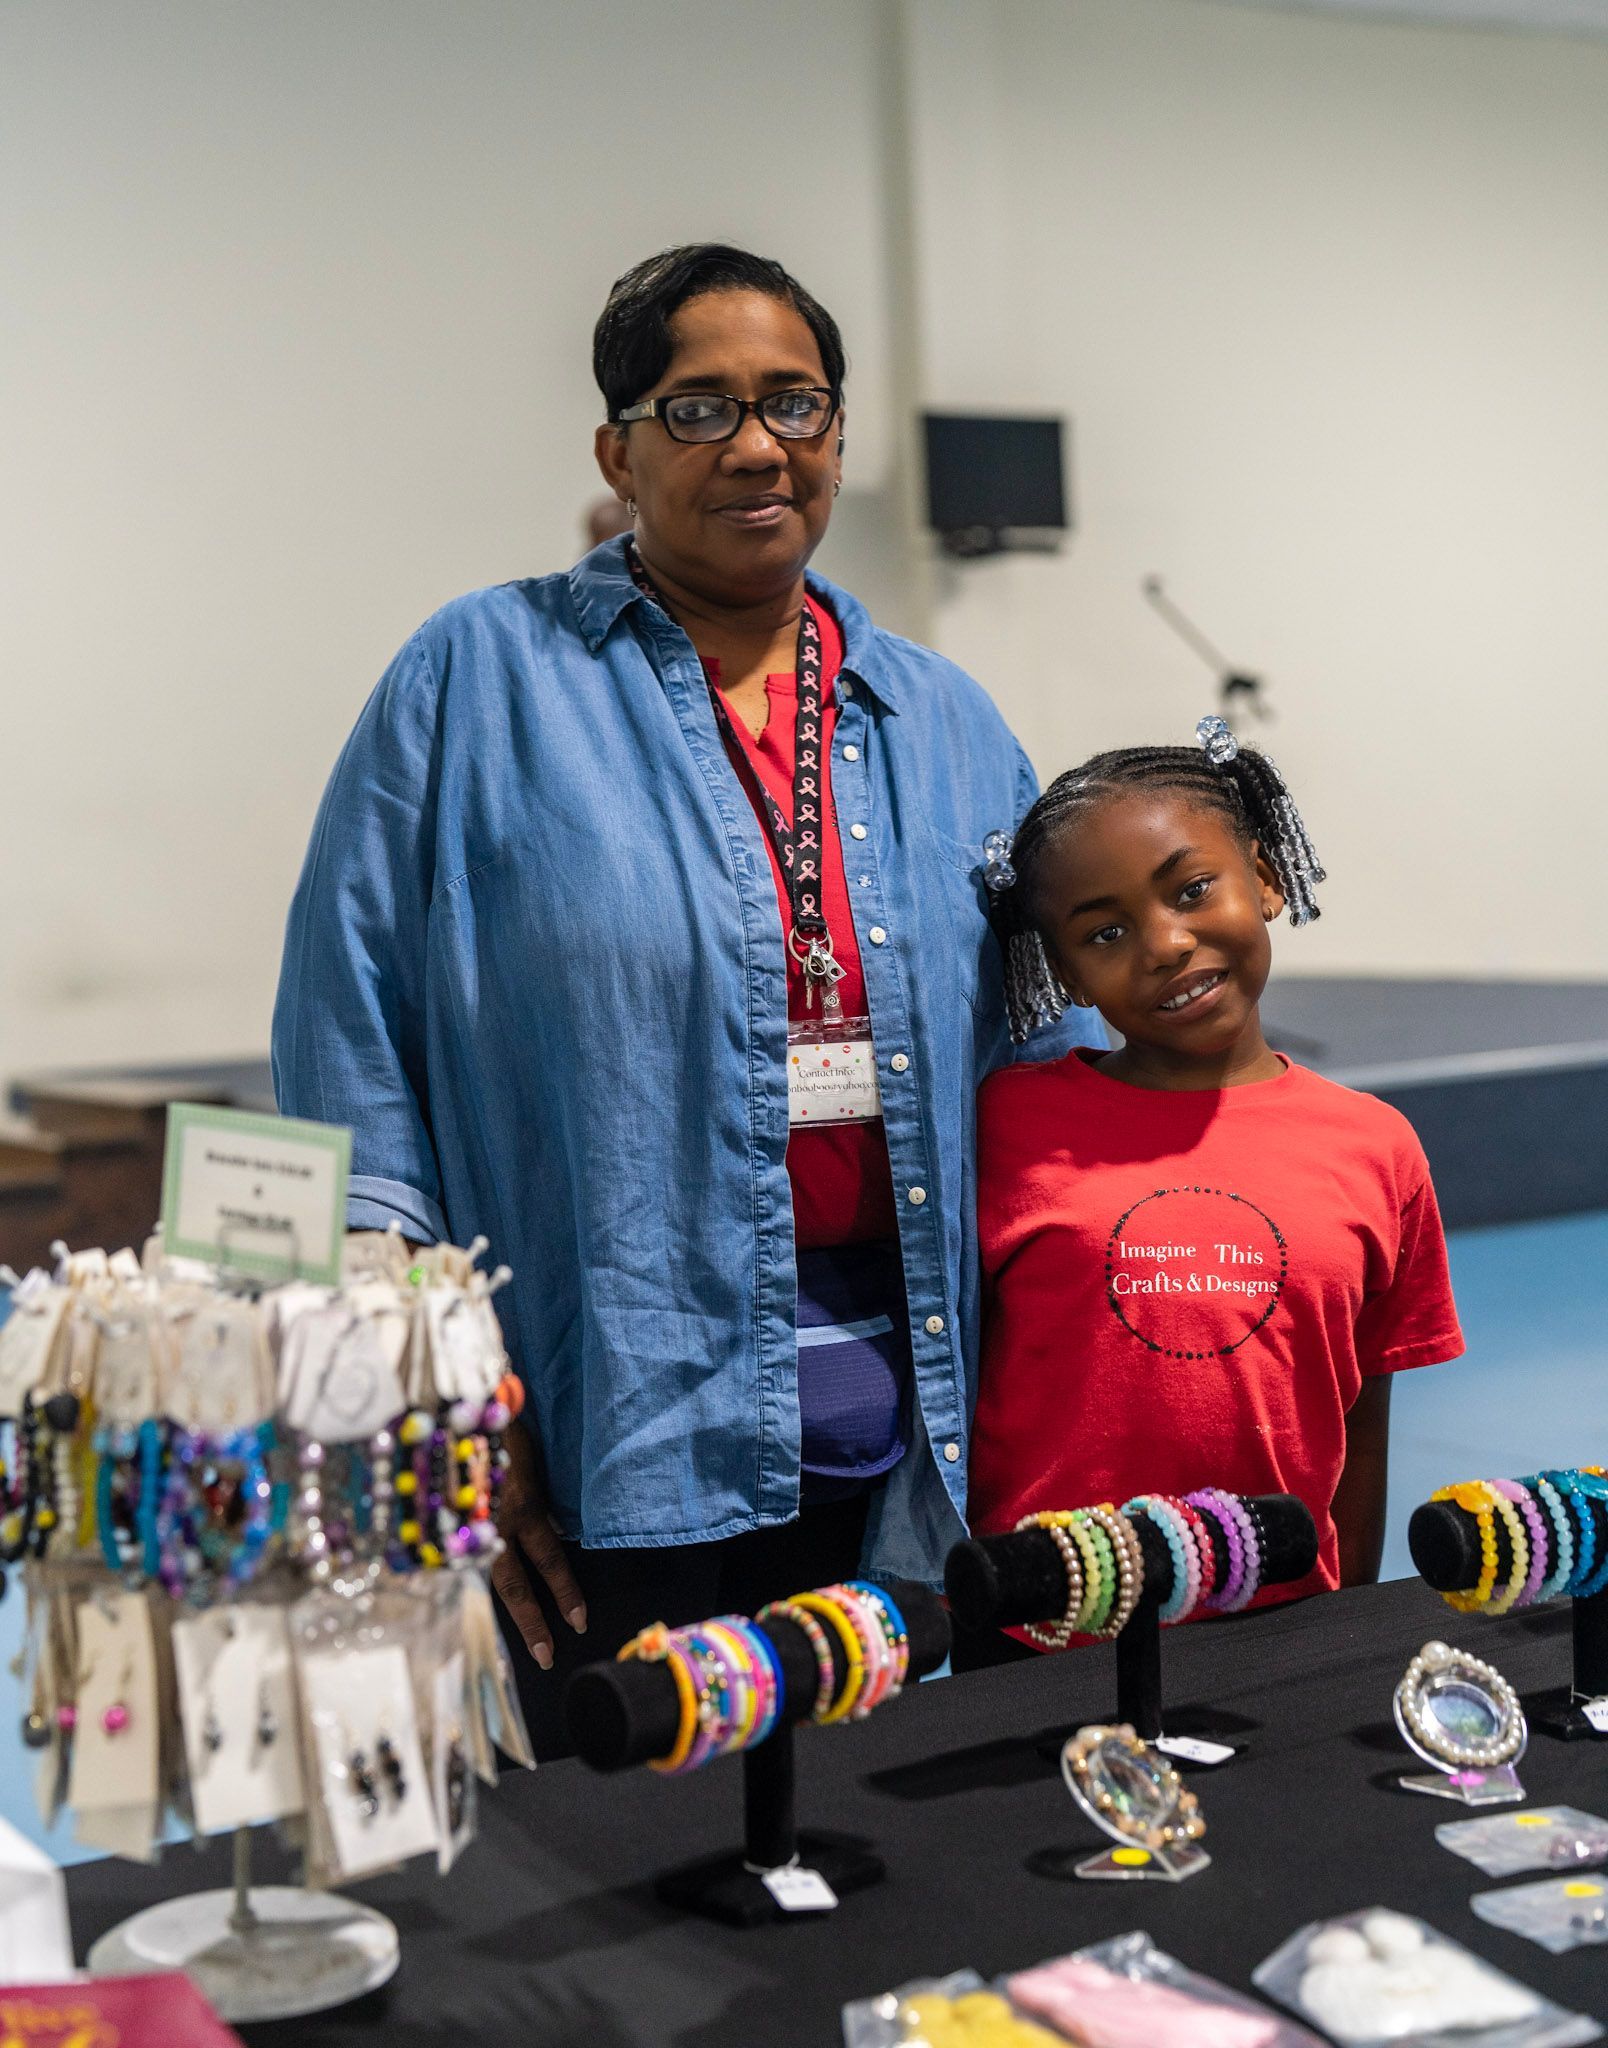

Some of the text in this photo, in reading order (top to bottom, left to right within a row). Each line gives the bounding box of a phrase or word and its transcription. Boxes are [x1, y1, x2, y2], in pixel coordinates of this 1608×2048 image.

[799, 1068, 834, 1078] Contact
[1120, 1241, 1264, 1264] Imagine This
[1112, 1271, 1278, 1297] Crafts & Designs
